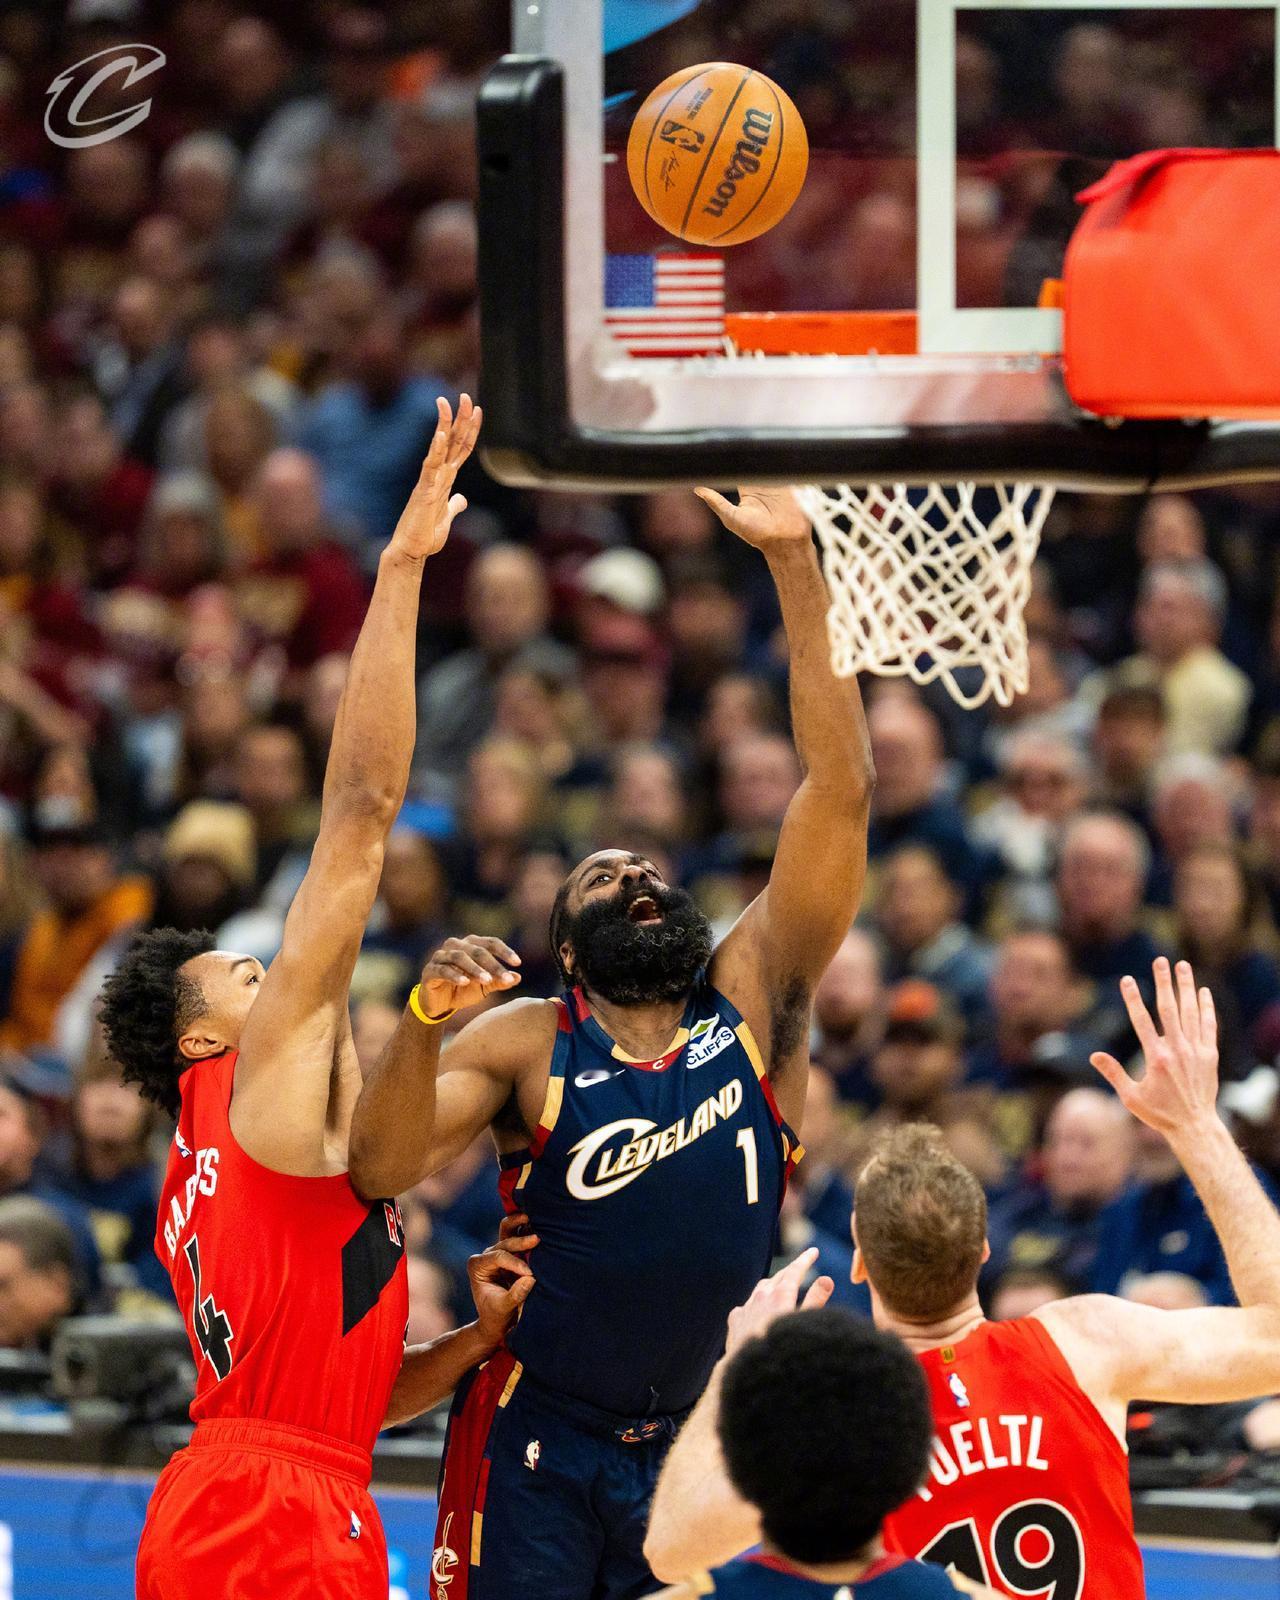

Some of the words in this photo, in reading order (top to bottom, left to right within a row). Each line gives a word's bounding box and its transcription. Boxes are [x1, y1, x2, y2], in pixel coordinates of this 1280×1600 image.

[703, 108, 774, 218] Wilson
[686, 1030, 732, 1066] CLIFFS
[566, 1078, 743, 1201] CLEVELAND
[735, 1127, 759, 1205] 1
[183, 1232, 234, 1381] 4
[914, 1415, 1049, 1502] OELTL
